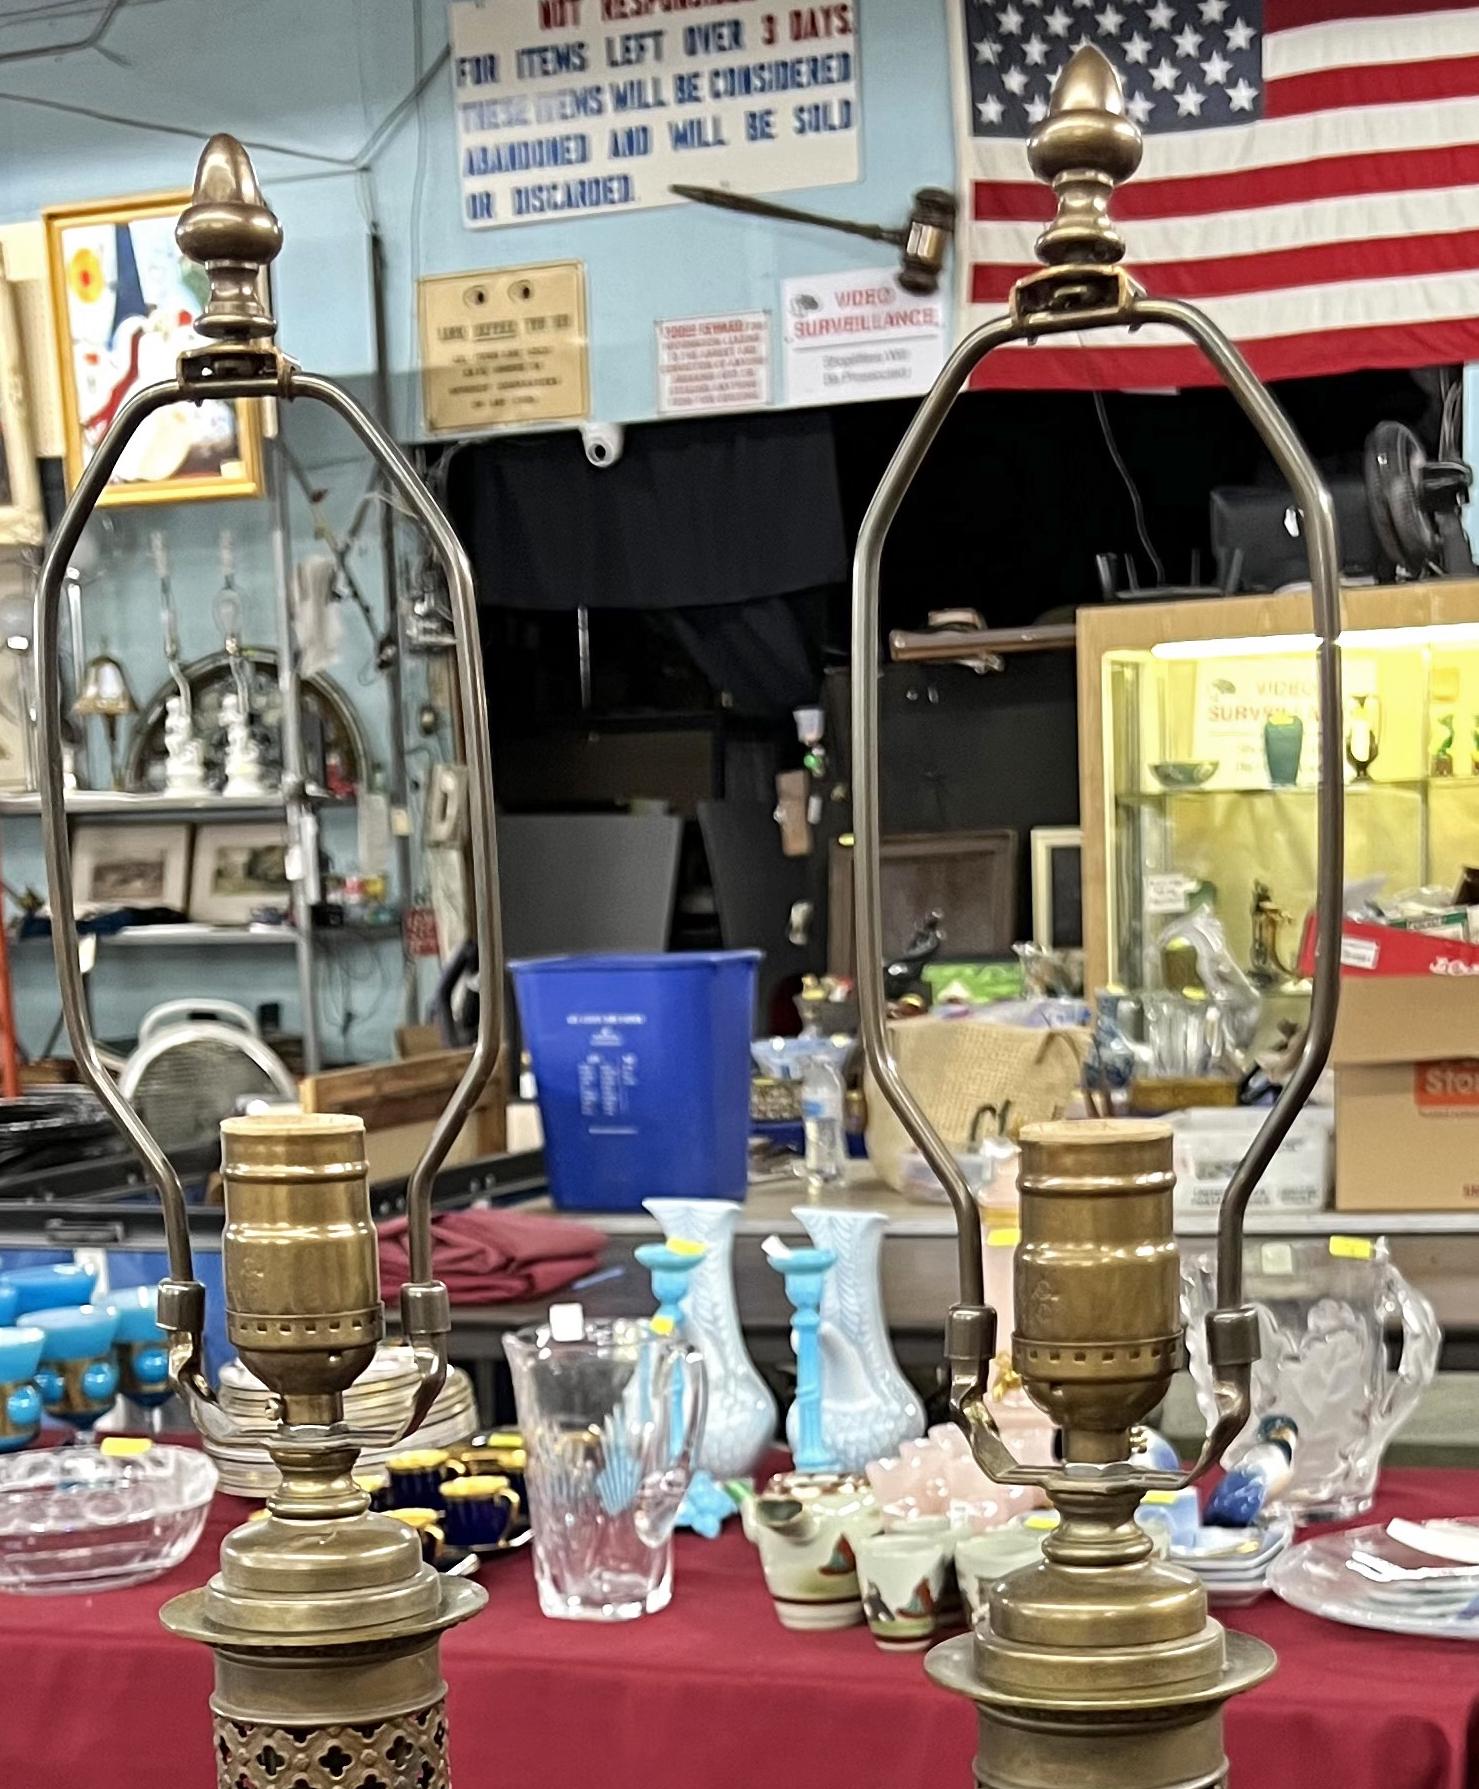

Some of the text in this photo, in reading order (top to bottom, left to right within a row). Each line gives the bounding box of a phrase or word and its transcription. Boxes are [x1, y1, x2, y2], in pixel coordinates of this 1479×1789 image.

[538, 0, 581, 30] NOT
[455, 53, 499, 87] FOR
[515, 41, 589, 80] ITEMS
[604, 29, 664, 67] LEFT
[683, 18, 743, 56] OVER
[760, 14, 777, 45] 3
[534, 85, 603, 126] ITEMS
[608, 76, 667, 112] WILL
[673, 71, 702, 104] BE
[708, 51, 851, 99] CONSIDERED
[462, 99, 853, 178] ABANDONED AND WILL BE SOLD
[466, 190, 496, 220] OR
[793, 307, 936, 340] SURVEILLANCE
